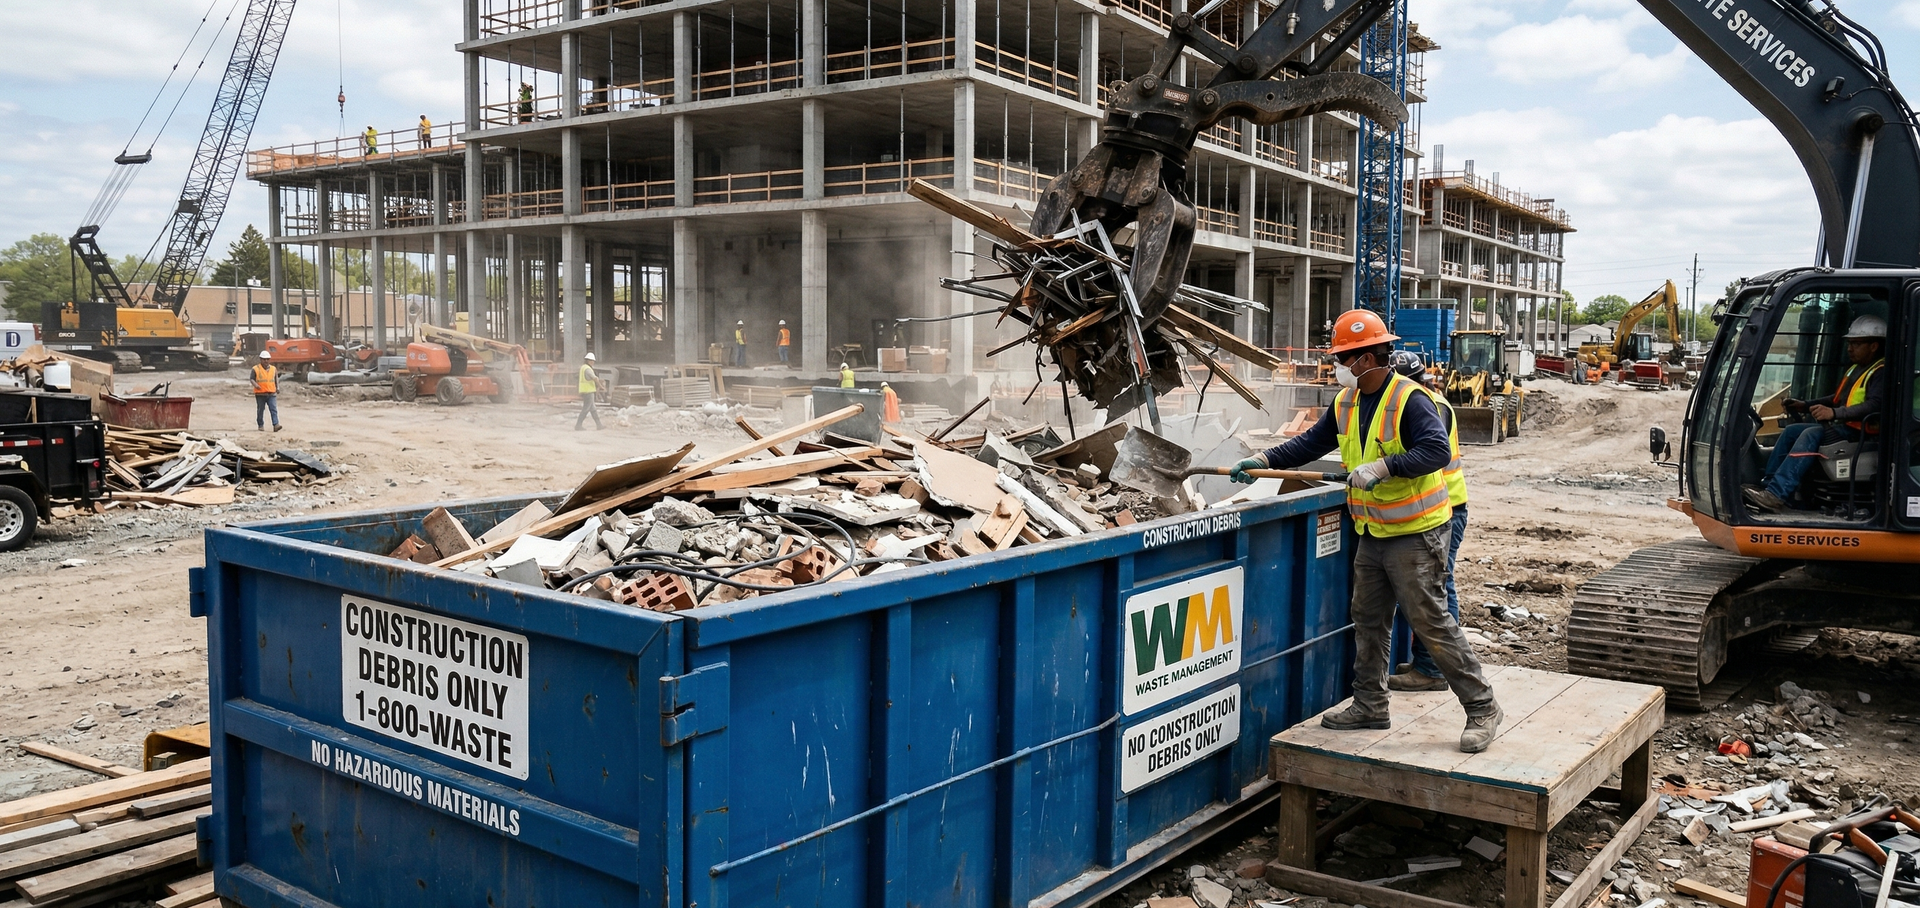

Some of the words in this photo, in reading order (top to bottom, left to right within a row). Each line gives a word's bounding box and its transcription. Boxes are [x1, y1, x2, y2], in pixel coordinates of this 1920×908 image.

[1727, 9, 1816, 88] SERVICES
[1143, 517, 1211, 549] CONSTRUCTION
[1212, 511, 1241, 533] DEBRIS
[1750, 533, 1782, 544] SITE
[1787, 534, 1860, 547] SERVICES
[346, 602, 523, 679] CONSTRUCTION
[1130, 584, 1234, 676] WM
[359, 646, 439, 701] DEBRIS
[447, 671, 509, 720] ONLY
[1135, 674, 1169, 696] WASTE
[1171, 649, 1234, 683] MANAGEMENT
[355, 689, 512, 769] 1-800-WASTE
[1128, 733, 1146, 758] NO
[1149, 695, 1236, 748] CONSTRUCTION
[1148, 737, 1192, 774] DEBRIS
[1195, 722, 1223, 751] ONLY
[311, 739, 331, 767] NO
[335, 747, 423, 800] HAZARDOUS
[427, 779, 520, 836] MATERIALS
